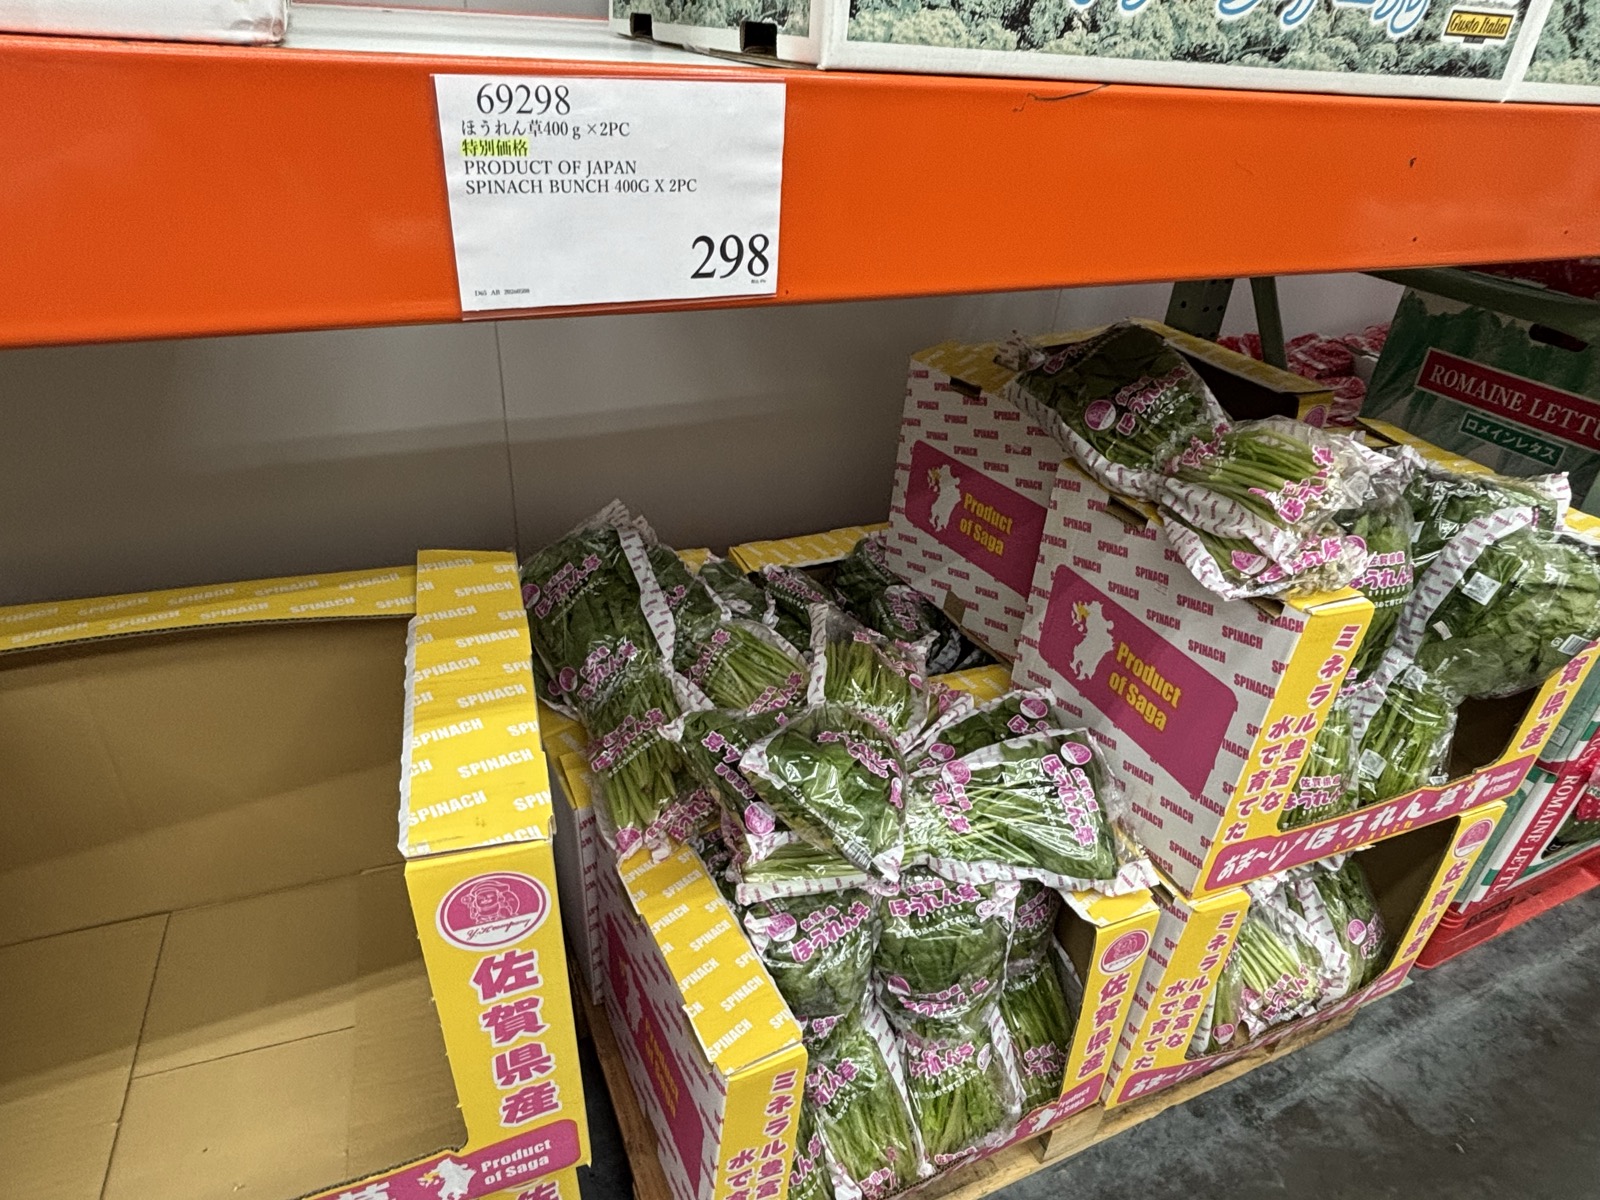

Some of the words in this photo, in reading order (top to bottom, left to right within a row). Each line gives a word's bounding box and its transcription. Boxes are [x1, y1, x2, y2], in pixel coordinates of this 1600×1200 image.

[1450, 13, 1479, 33] Gusto
[1479, 15, 1508, 36] Italia
[476, 84, 571, 116] 69298
[461, 139, 528, 157] 特別価格
[464, 160, 552, 176] PRODUCT
[558, 160, 581, 175] OF
[585, 160, 637, 178] JAPAN
[465, 179, 543, 195] SPINACH
[549, 179, 609, 195] BUNCH
[614, 178, 650, 193] 400G
[654, 178, 665, 192] X
[669, 178, 698, 193] 2PC
[690, 233, 770, 280] 298
[1429, 364, 1527, 413] ROMAINE
[1465, 419, 1558, 460] ロメインレタス
[1015, 477, 1043, 490] SPINACH
[963, 492, 1013, 535] Product
[1063, 516, 1092, 533] SPINACH
[959, 518, 972, 534] of
[973, 521, 1005, 556] Saga
[1098, 540, 1128, 558] SPINACH
[1073, 555, 1102, 574] SPINACH
[1136, 566, 1169, 586] SPINACH
[455, 581, 514, 597] SPINACH
[1108, 581, 1139, 600] SPINACH
[1146, 609, 1181, 631] SPINACH
[1176, 594, 1214, 616] SPINACH
[455, 628, 520, 648] SPINACH
[1188, 639, 1226, 664] SPINACH
[1222, 625, 1264, 650] SPINACH
[413, 656, 480, 683] SPINACH
[1027, 669, 1052, 689] SPINACH
[1115, 642, 1183, 709] Product
[456, 684, 527, 708] SPINACH
[1108, 671, 1126, 692] of
[1126, 681, 1168, 732] Saga
[1233, 673, 1276, 700] SPINACH
[1055, 697, 1083, 719] SPINACH
[1261, 625, 1361, 811] ミネラル豊富な
[1519, 655, 1590, 752] 賀県産
[411, 717, 485, 749] SPINACH
[1088, 726, 1117, 751] SPINACH
[457, 748, 535, 779] SPINACH
[1122, 759, 1154, 786] SPINACH
[1224, 715, 1291, 842] 水で育てた
[408, 789, 488, 827] SPINACH
[1131, 802, 1164, 830] SPINACH
[1160, 796, 1194, 824] SPINACH
[1304, 784, 1464, 851] ほうれん草
[1525, 774, 1581, 844] ROMAINE
[1333, 821, 1414, 851] SPINACH
[1169, 840, 1204, 870] SPINACH
[662, 868, 703, 899] SPINACH
[889, 882, 980, 917] ほうれん草
[650, 903, 691, 936] SPINACH
[792, 901, 870, 962] ほうれん草
[690, 919, 732, 953] SPINACH
[679, 957, 720, 994] SPINACH
[1166, 912, 1239, 1049] ミネラル豊富な
[720, 975, 765, 1012] SPINACH
[472, 950, 559, 1124] 佐賀県産
[708, 1018, 753, 1060] SPINACH
[1078, 974, 1130, 1079] 佐賀県産
[1134, 980, 1188, 1070] 水で育てた
[480, 1139, 552, 1173] Product
[485, 1172, 502, 1185] of
[507, 1156, 550, 1178] Saga
